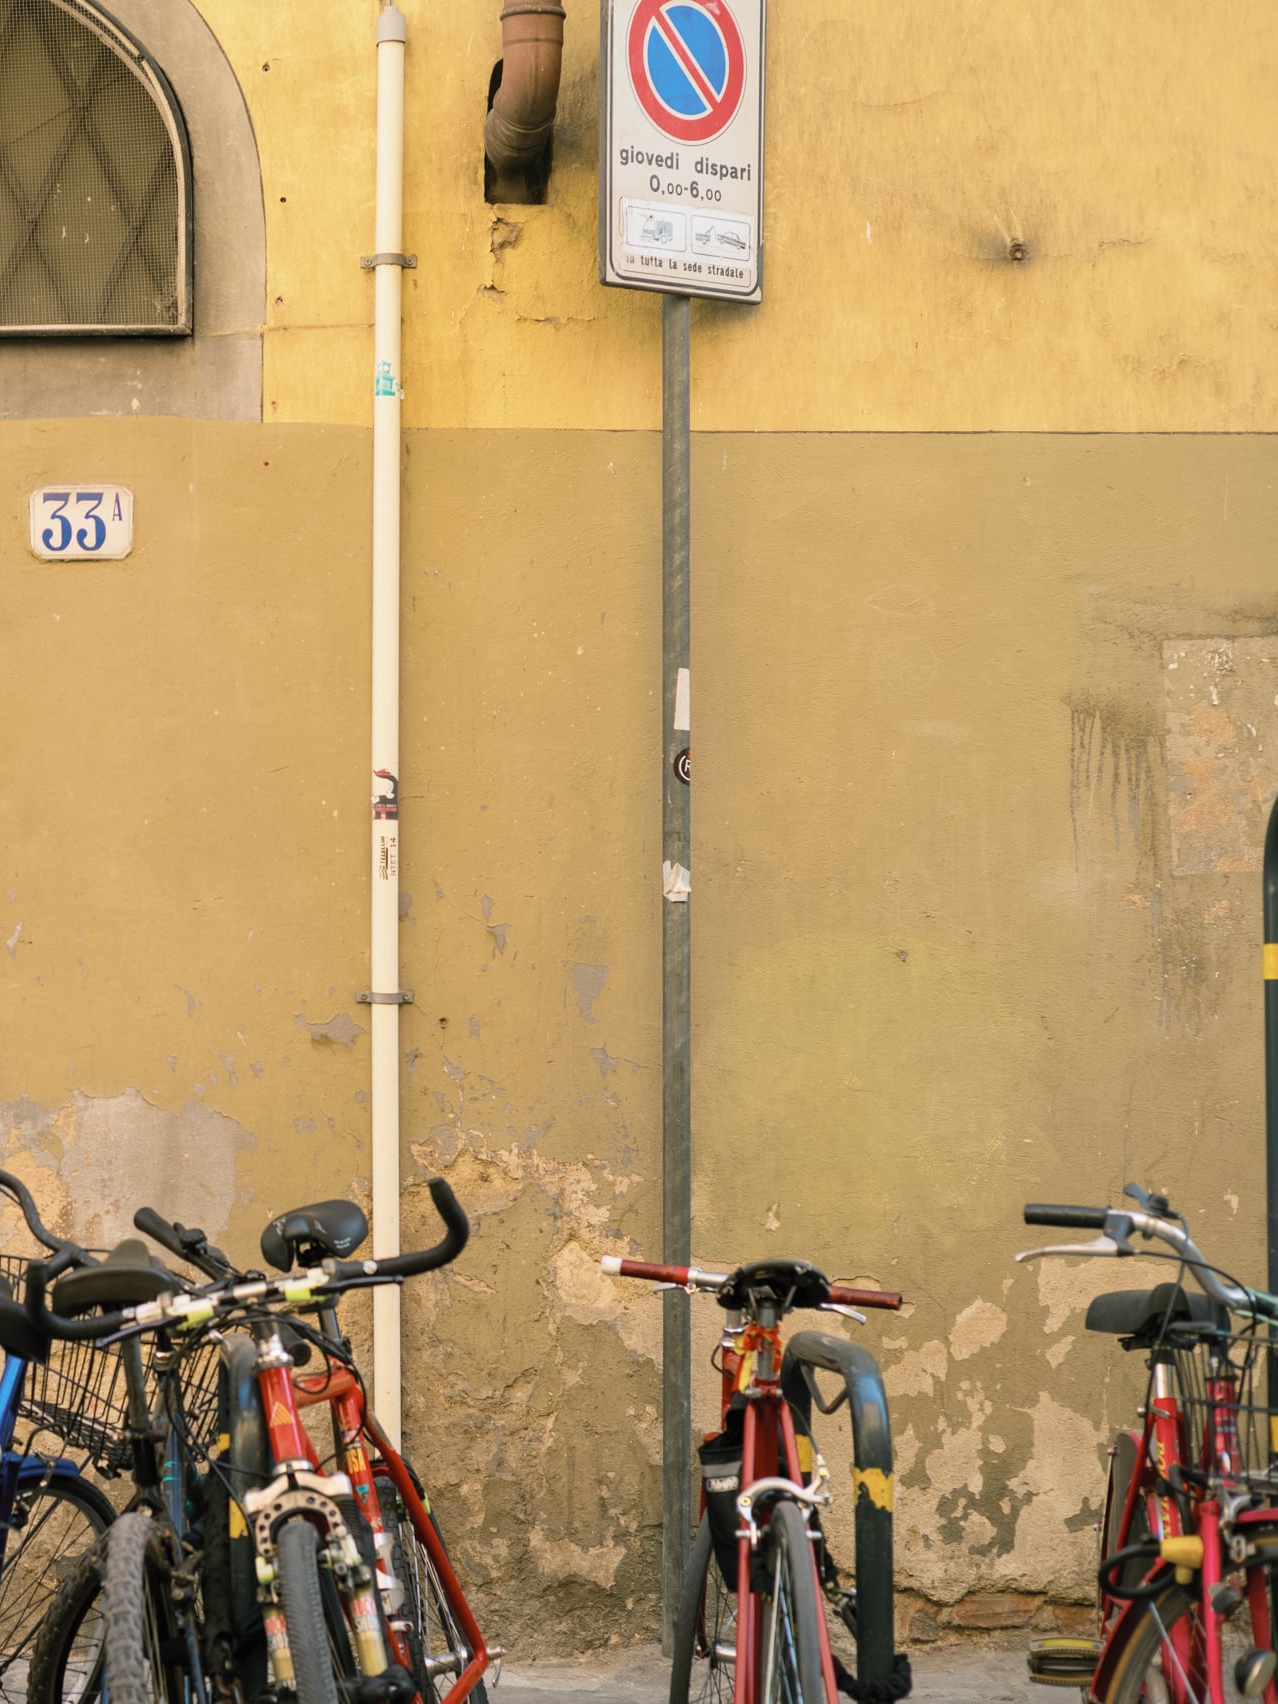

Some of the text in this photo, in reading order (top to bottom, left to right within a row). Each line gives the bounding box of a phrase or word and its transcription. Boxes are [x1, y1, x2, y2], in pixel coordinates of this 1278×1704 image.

[619, 145, 752, 181] giovedi dispari
[649, 174, 722, 202] 0,00-6,00
[640, 255, 663, 268] tutta
[669, 258, 678, 270] la
[683, 261, 703, 274] sede
[707, 264, 745, 279] stradale
